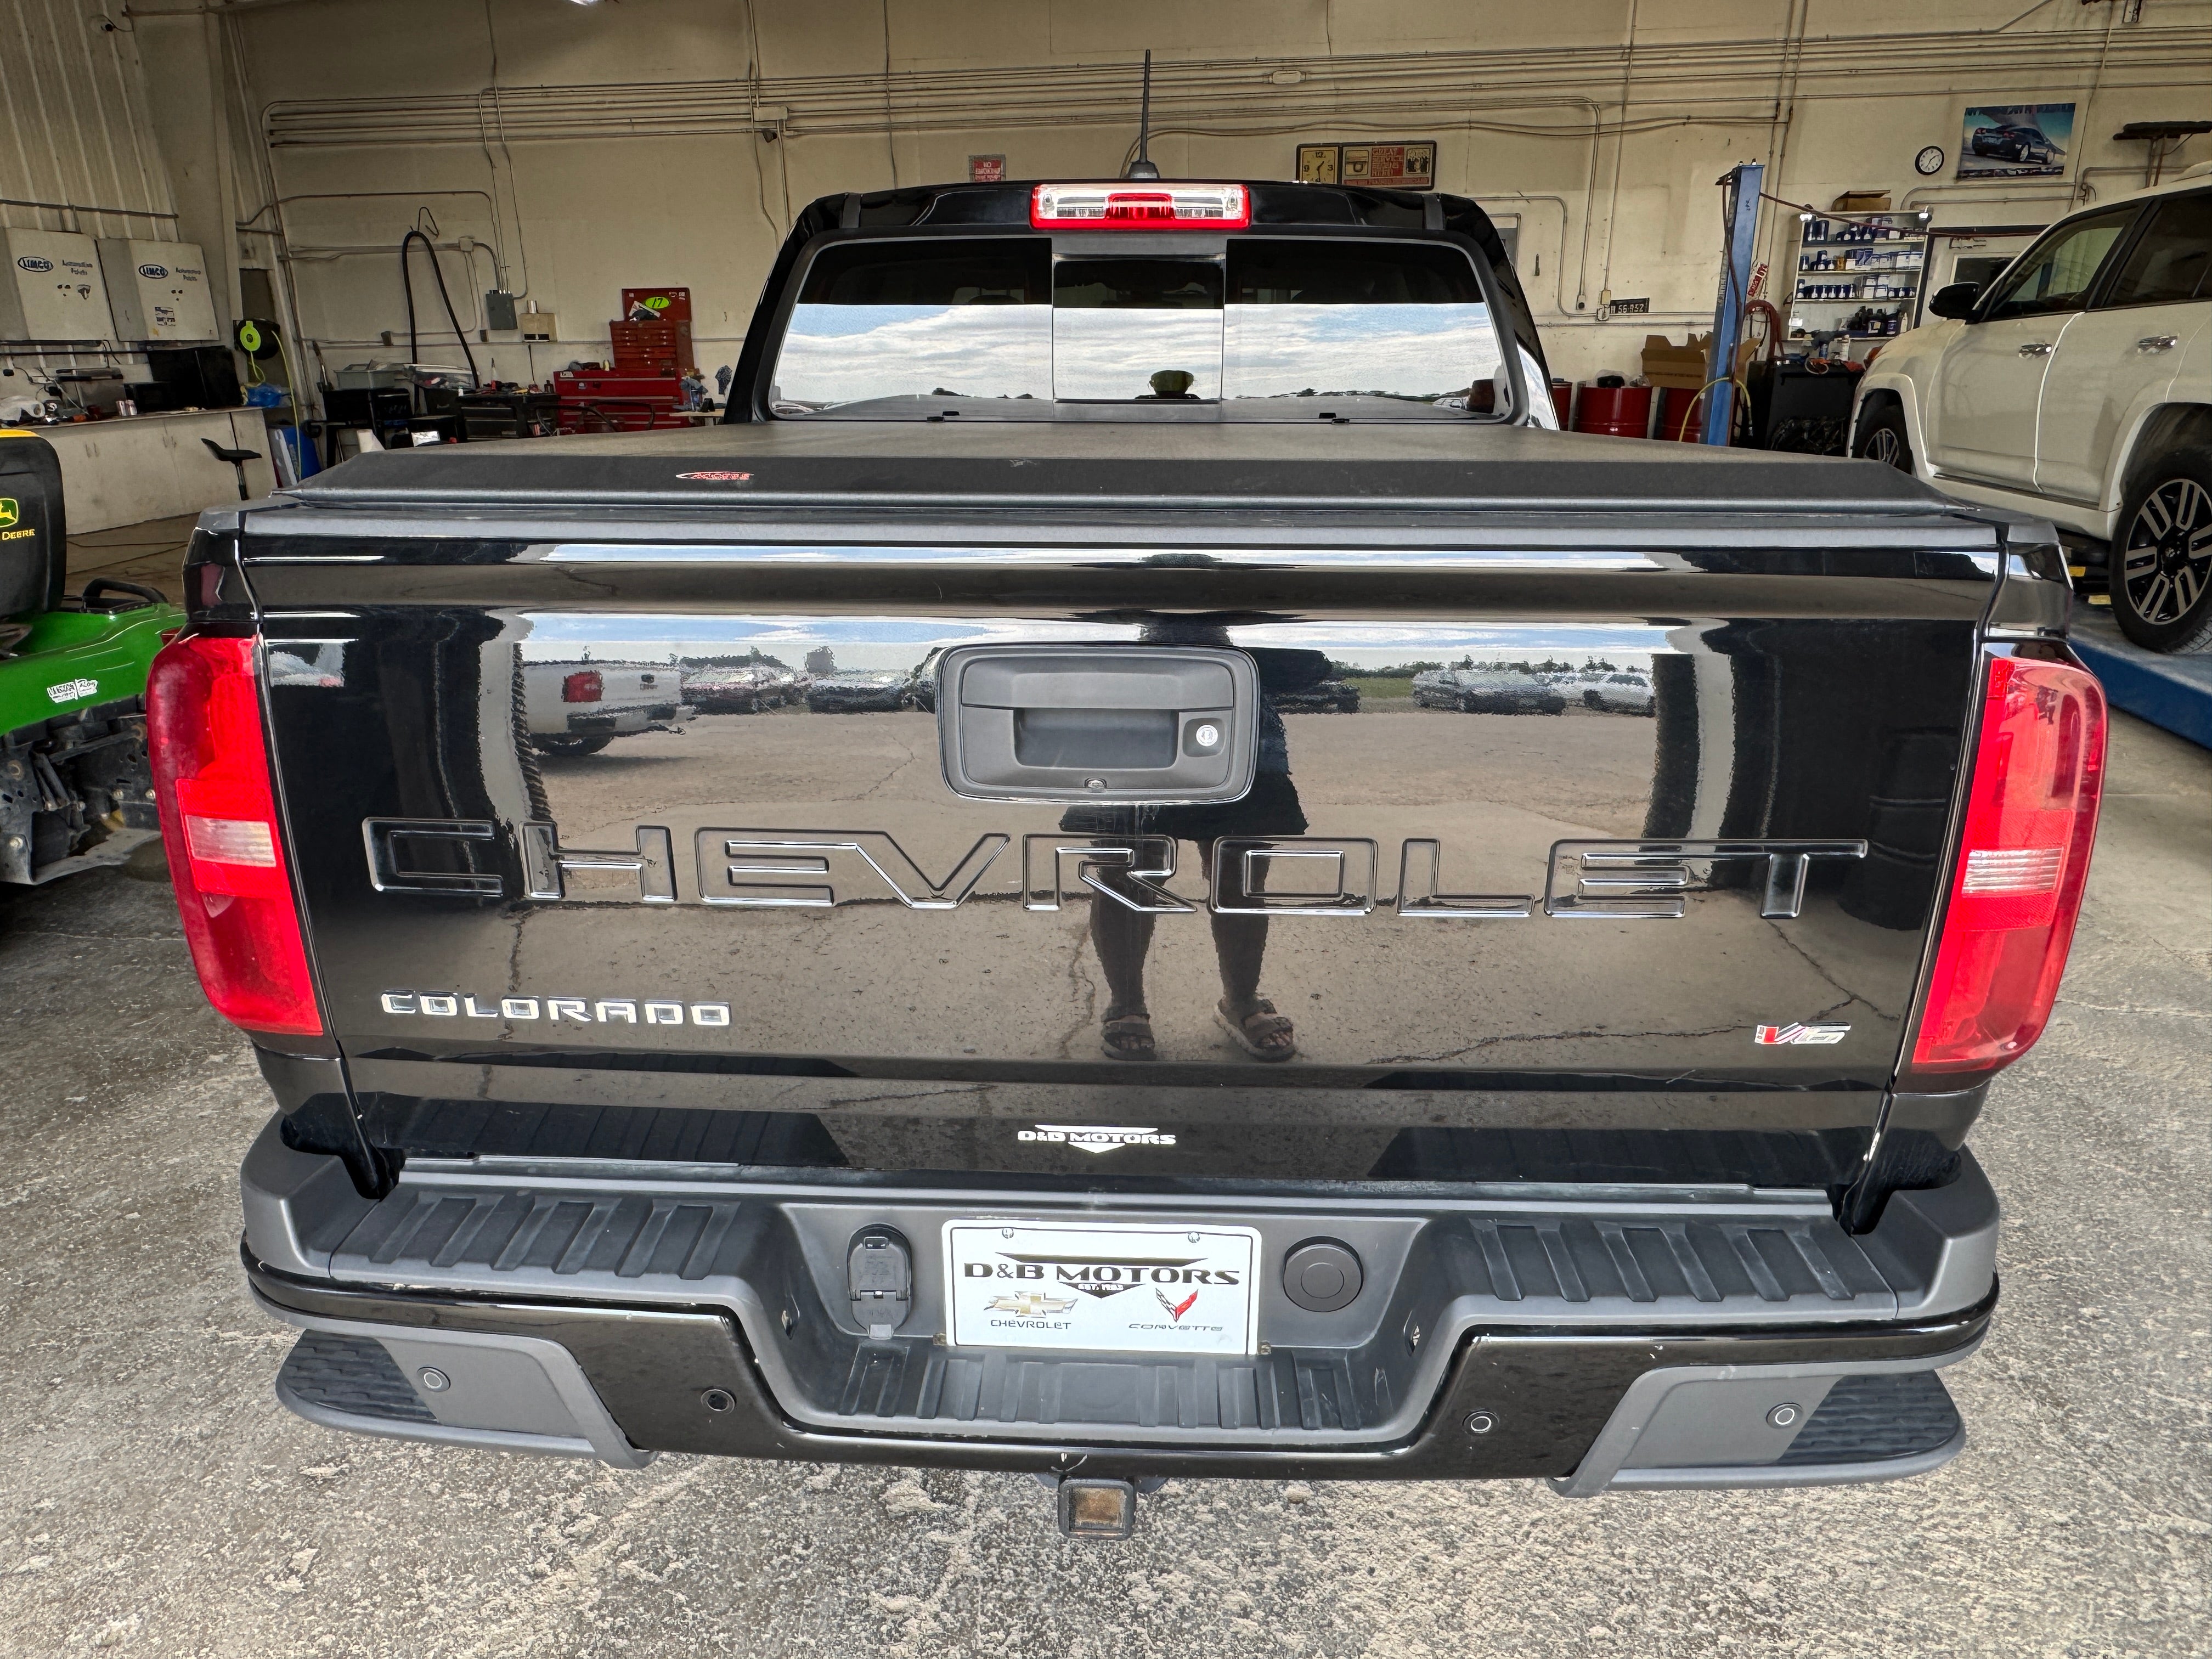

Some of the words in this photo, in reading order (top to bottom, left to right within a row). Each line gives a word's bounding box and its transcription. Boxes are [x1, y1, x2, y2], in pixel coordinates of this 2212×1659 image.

[2, 529, 36, 540] DEERE
[362, 816, 1869, 920] CHEVROLET
[381, 990, 732, 1026] COLORADO
[1017, 1130, 1066, 1142] D&B
[1069, 1132, 1177, 1145] MOTORS
[964, 1263, 1045, 1279] D&B
[1056, 1265, 1240, 1286] MOTORS
[990, 1319, 1072, 1330] CHEVROLET
